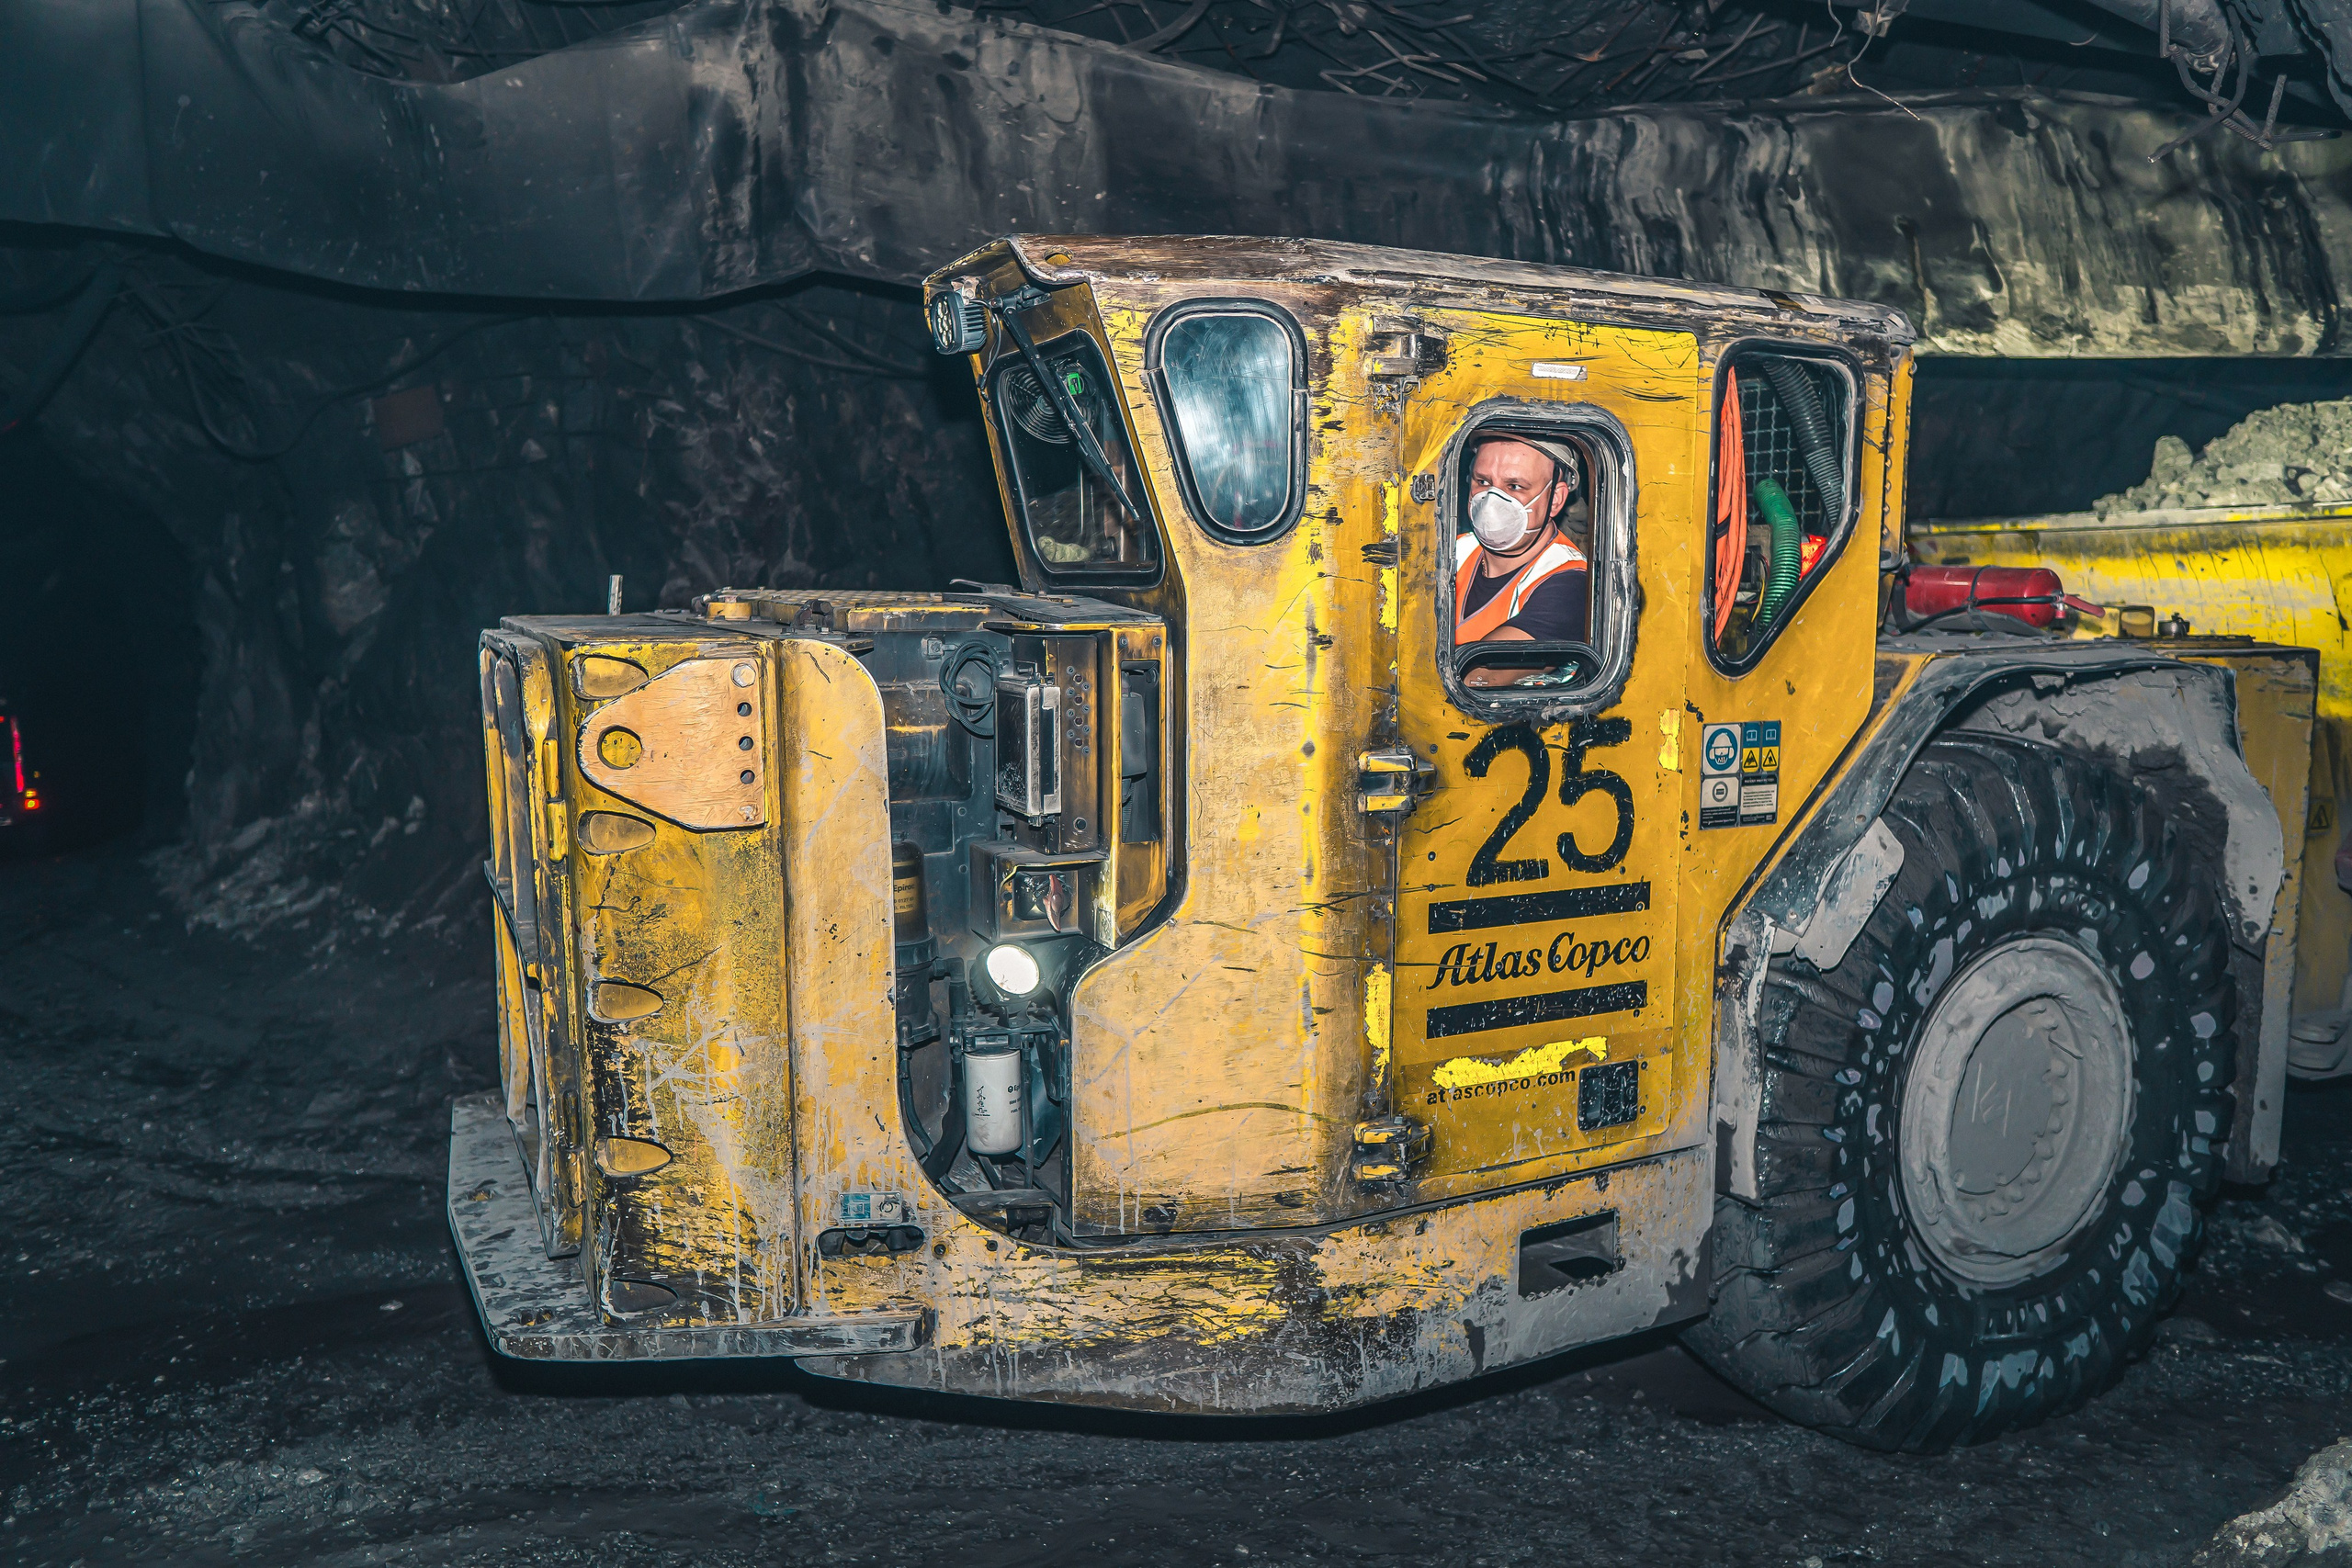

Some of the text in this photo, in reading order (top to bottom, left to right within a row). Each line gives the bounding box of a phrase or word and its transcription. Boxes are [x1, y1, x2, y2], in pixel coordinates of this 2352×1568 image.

[1463, 716, 1635, 887] 25
[894, 884, 915, 893] Epiroc
[1426, 931, 1651, 990] Atlas Copco
[1426, 1069, 1576, 1105] atascopco.com
